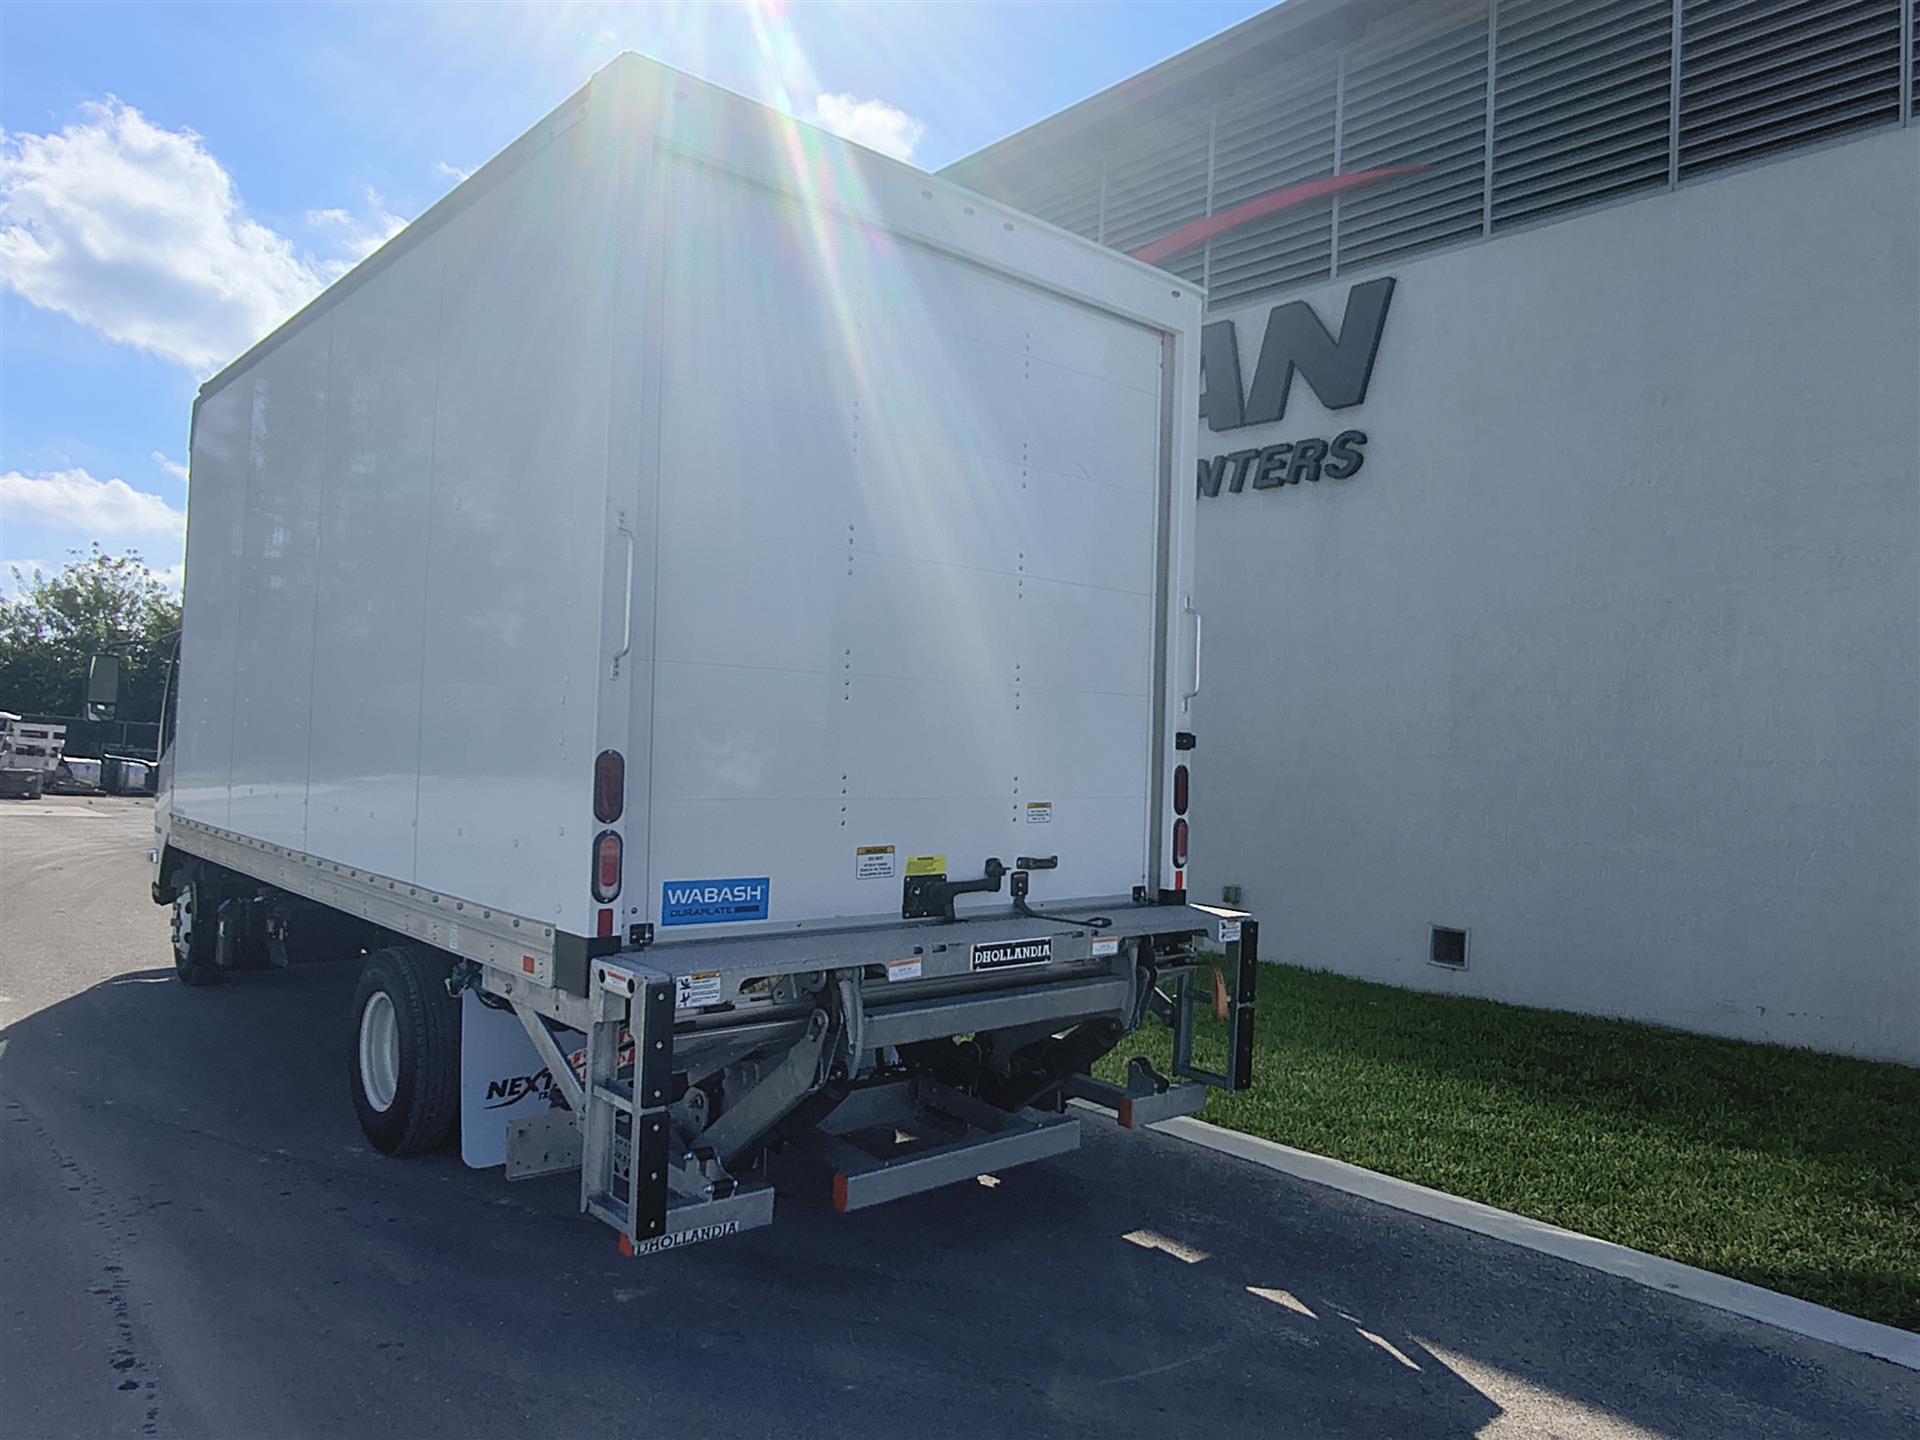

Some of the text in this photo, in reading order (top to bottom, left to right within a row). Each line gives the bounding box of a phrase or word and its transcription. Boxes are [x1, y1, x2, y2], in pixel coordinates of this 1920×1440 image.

[1197, 430, 1368, 500] NTERS
[668, 886, 761, 905] WABASH
[975, 944, 1051, 964] DHOLLANDIA
[637, 1222, 738, 1255] DHOLLANDIA
